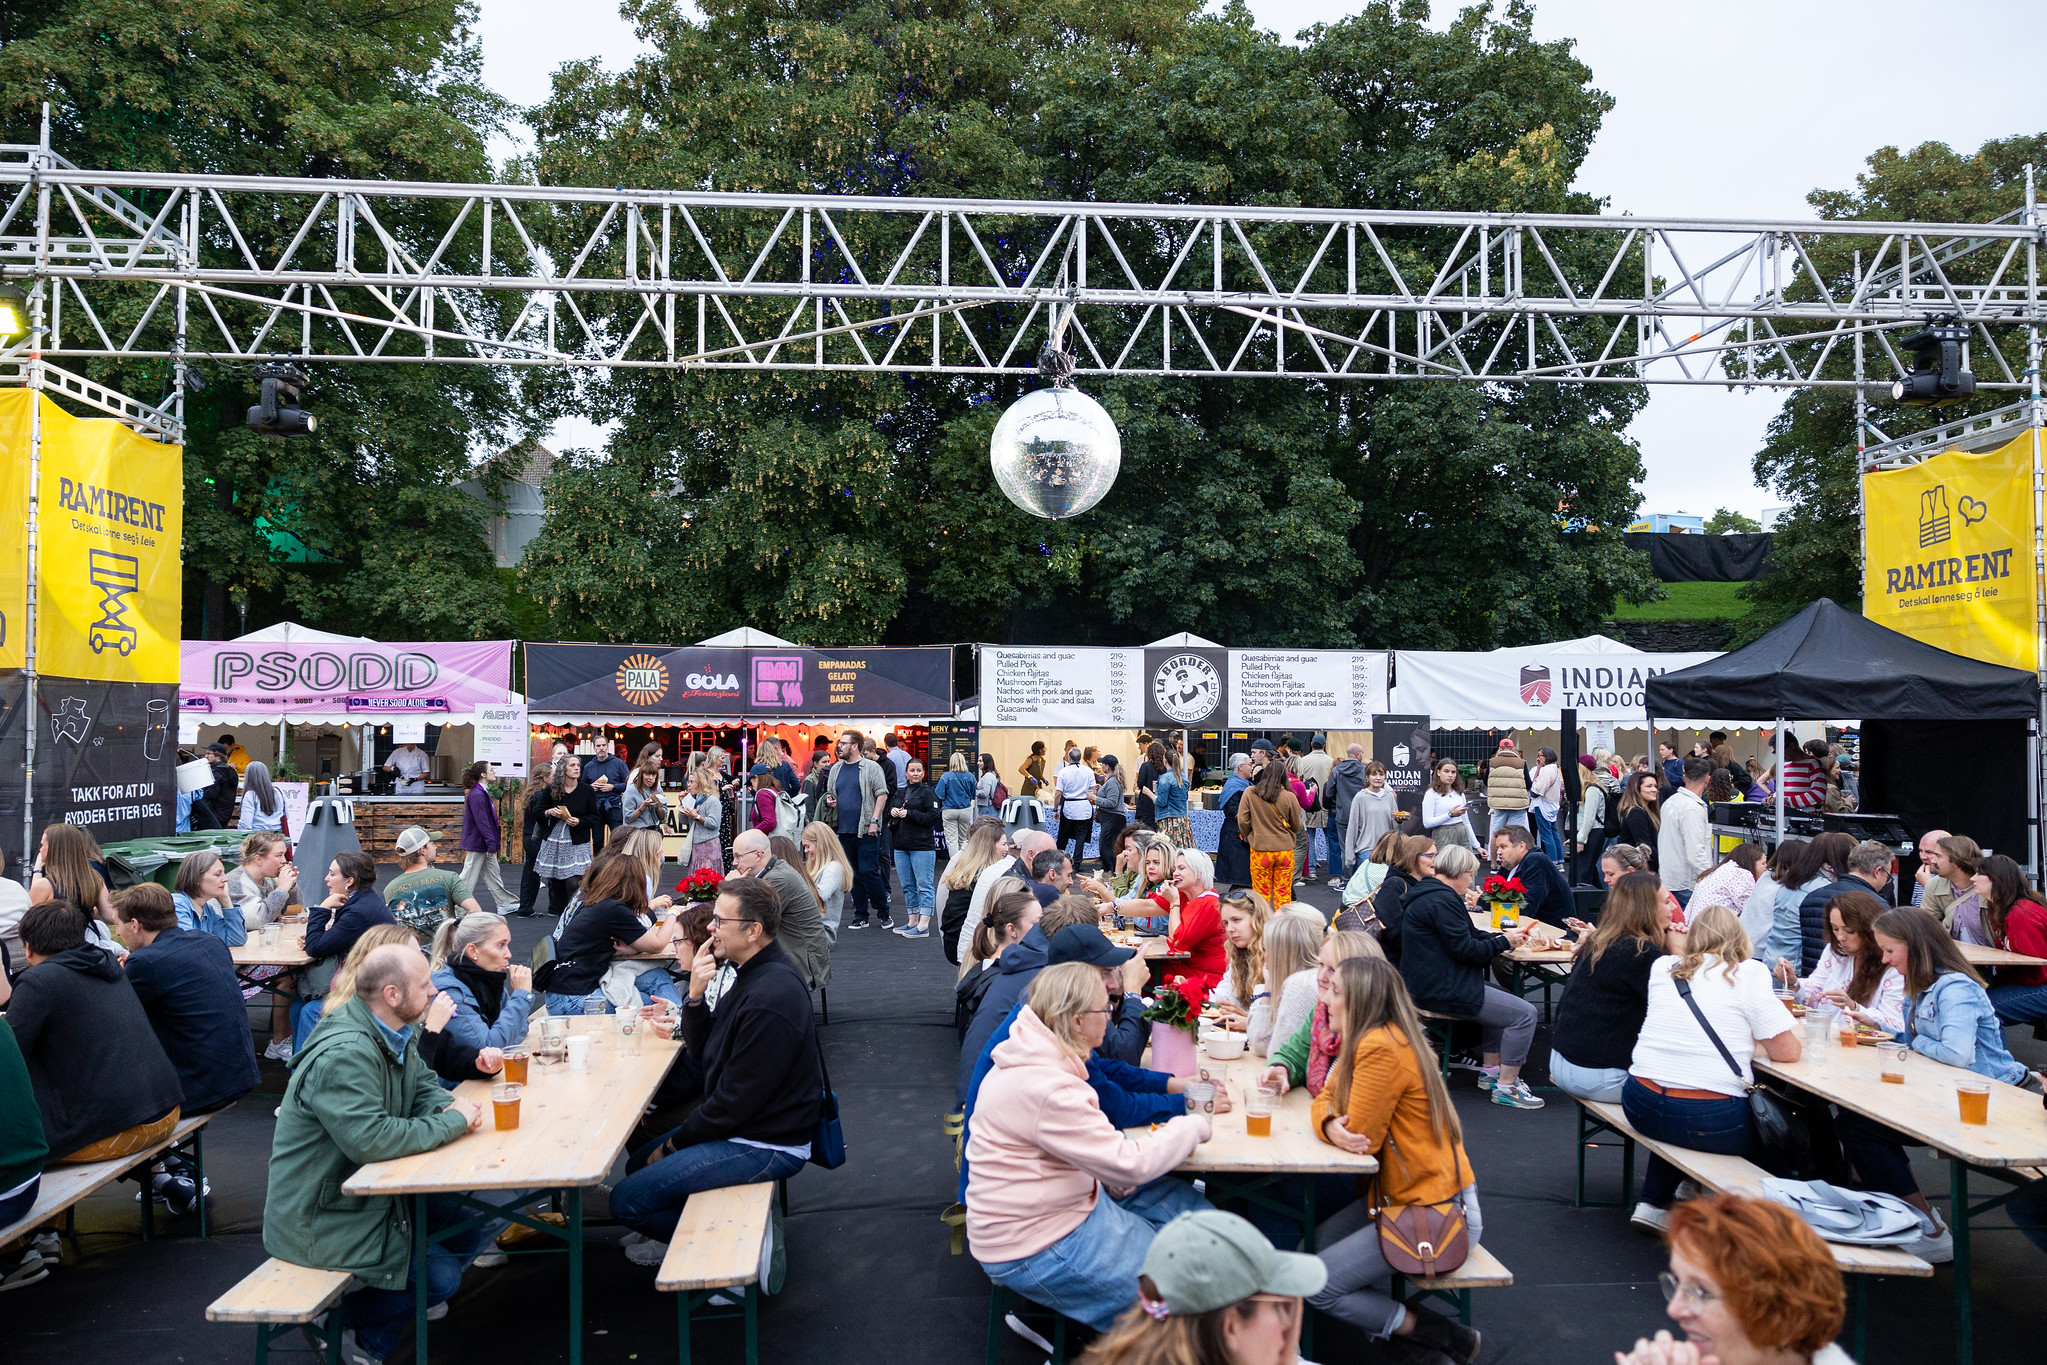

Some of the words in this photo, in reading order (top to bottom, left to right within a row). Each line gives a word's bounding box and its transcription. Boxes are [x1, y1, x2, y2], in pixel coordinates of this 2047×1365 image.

[59, 477, 165, 532] RAMIRENT
[71, 519, 86, 530] Det
[86, 522, 102, 535] skal
[140, 535, 156, 547] leie
[1886, 548, 2012, 594] RAMIRENT
[1899, 598, 1913, 608] Det
[1914, 595, 1931, 606] skal
[1956, 591, 1972, 602] seg
[1974, 587, 1981, 598] å
[1982, 586, 1999, 597] leie
[1058, 653, 1075, 661] guac
[1301, 656, 1317, 664] guac
[818, 661, 866, 669] EMPANADAS
[997, 660, 1019, 668] Pulled
[213, 651, 439, 692] PSODD
[827, 672, 857, 680] GELATO
[997, 669, 1026, 677] Chicken
[1027, 669, 1049, 678] fajitas
[1157, 678, 1166, 693] LA
[1162, 657, 1212, 676] BORDER
[1271, 672, 1292, 681] fajitas
[628, 672, 657, 688] PALA
[686, 673, 739, 690] GOLA
[997, 678, 1037, 686] Mushroom
[1039, 679, 1062, 688] Fajitas
[830, 683, 854, 692] KAFFE
[1282, 681, 1305, 690] Fajitas
[997, 687, 1024, 695] Nachos
[1042, 688, 1058, 696] pork
[1075, 689, 1092, 697] guac
[1241, 689, 1268, 697] Nachos
[1286, 690, 1301, 699] pork
[368, 698, 388, 707] NEVER
[389, 698, 407, 707] SODD
[408, 698, 428, 707] ALONE
[830, 695, 855, 703] BAKST
[1163, 702, 1209, 719] BURRITO
[1207, 682, 1218, 706] BAR
[1241, 698, 1268, 706] Nachos
[1286, 700, 1302, 708] guac
[1562, 692, 1646, 707] TANDOO
[482, 710, 520, 720] MENY
[1241, 707, 1281, 715] Guacamole
[931, 725, 949, 733] MENY
[1386, 770, 1421, 779] NDIAN
[71, 786, 101, 802] TAKK
[102, 785, 123, 800] FOR
[125, 784, 138, 798] AT
[140, 783, 154, 797] DU
[64, 808, 106, 825] RYDDER
[107, 805, 140, 822] ETTER
[142, 803, 162, 818] DEG
